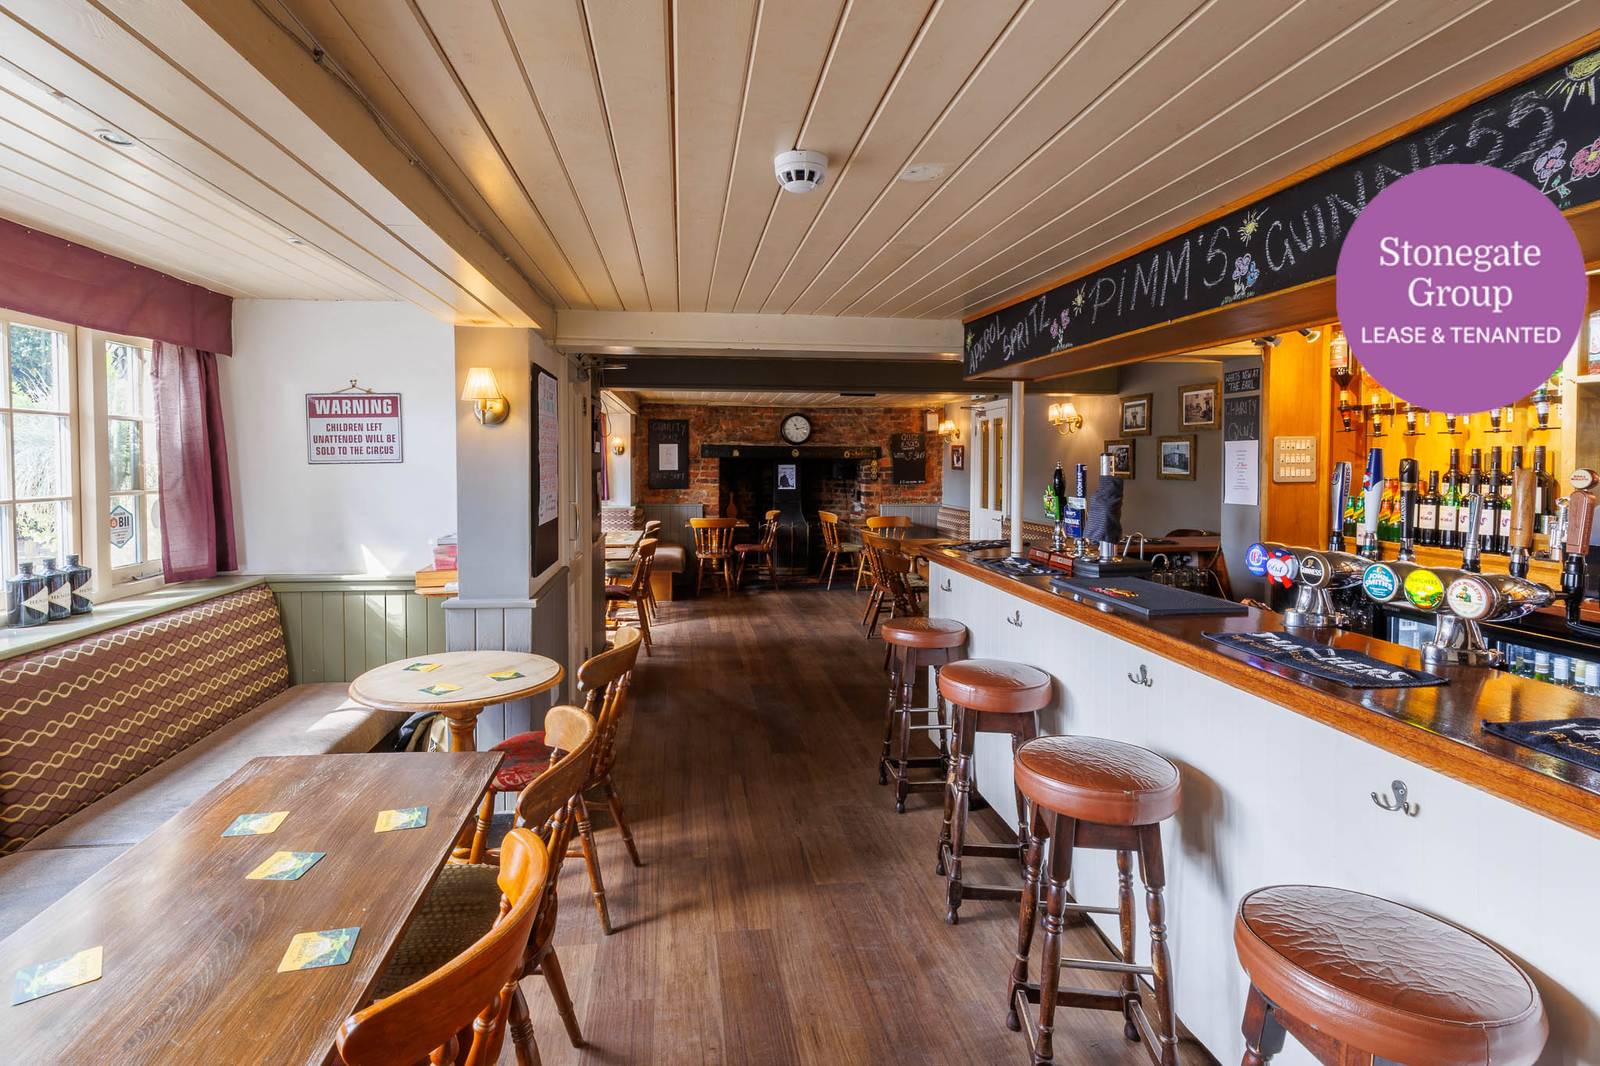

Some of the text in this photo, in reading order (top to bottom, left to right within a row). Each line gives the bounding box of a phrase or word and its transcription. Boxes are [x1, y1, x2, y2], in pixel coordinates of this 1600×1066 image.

[969, 315, 1006, 374] APEROL
[1002, 295, 1051, 362] SPRITZ
[314, 398, 393, 415] WARNING
[326, 422, 383, 432] CHILDREN LEFT
[313, 434, 397, 444] UNATTENDED WILL BE
[315, 446, 394, 456] SOLD TO THE CIRCUS
